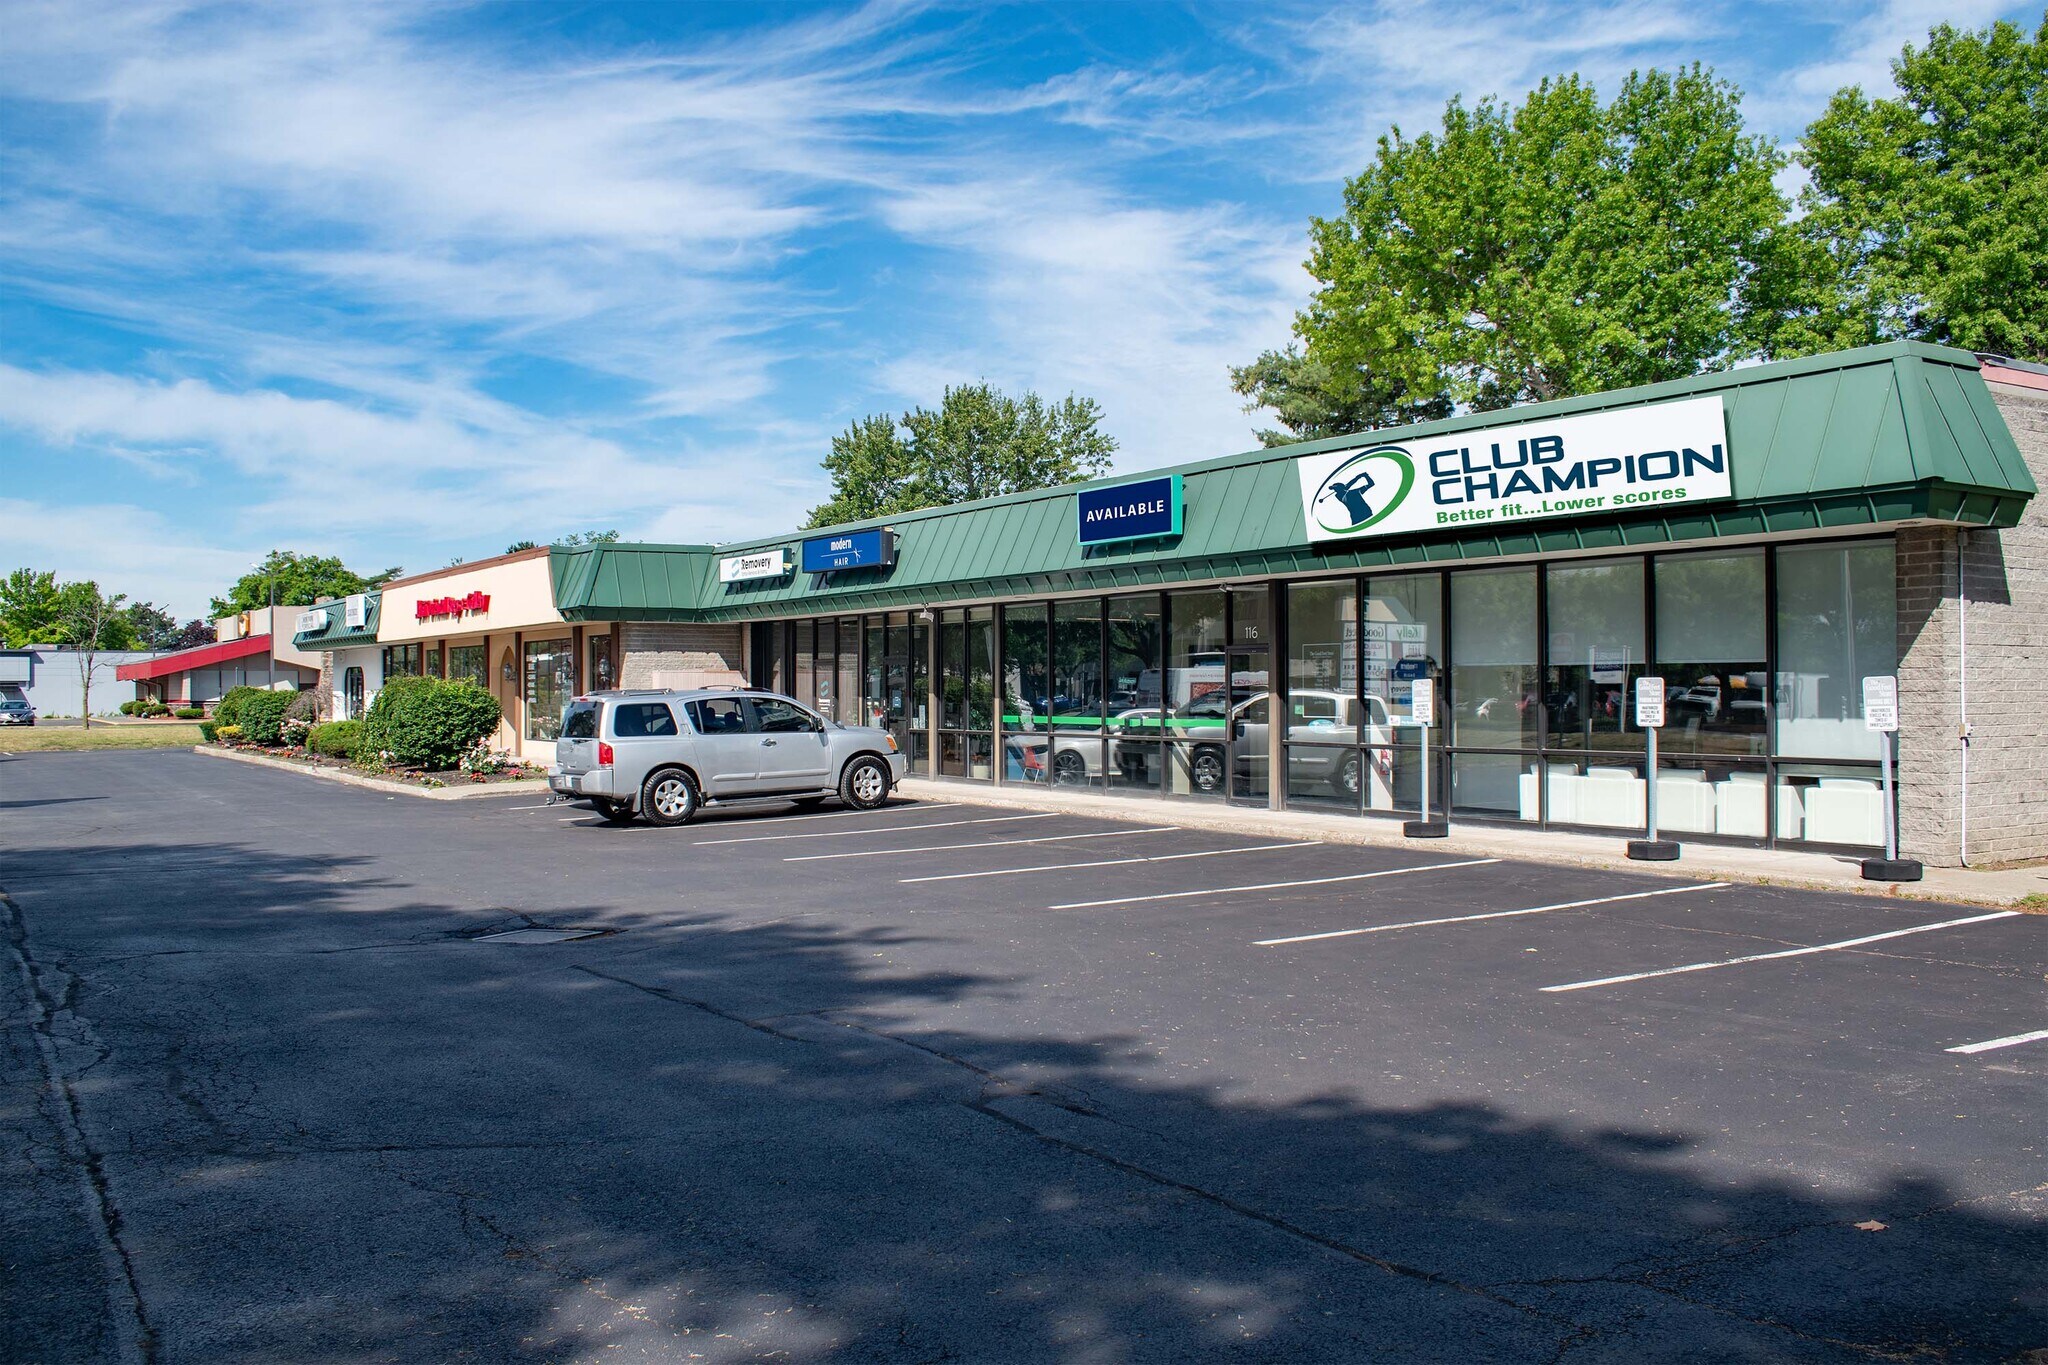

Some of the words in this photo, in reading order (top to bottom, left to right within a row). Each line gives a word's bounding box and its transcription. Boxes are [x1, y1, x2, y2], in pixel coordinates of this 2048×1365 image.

[1429, 435, 1564, 478] CLUB
[1432, 444, 1724, 505] CHAMPION
[1086, 500, 1164, 522] AVAILABLE
[1436, 505, 1495, 524] Better
[1613, 486, 1687, 505] scores
[830, 538, 852, 551] modern
[740, 557, 772, 570] Removery
[833, 557, 849, 567] HAIR
[1245, 626, 1258, 639] 116
